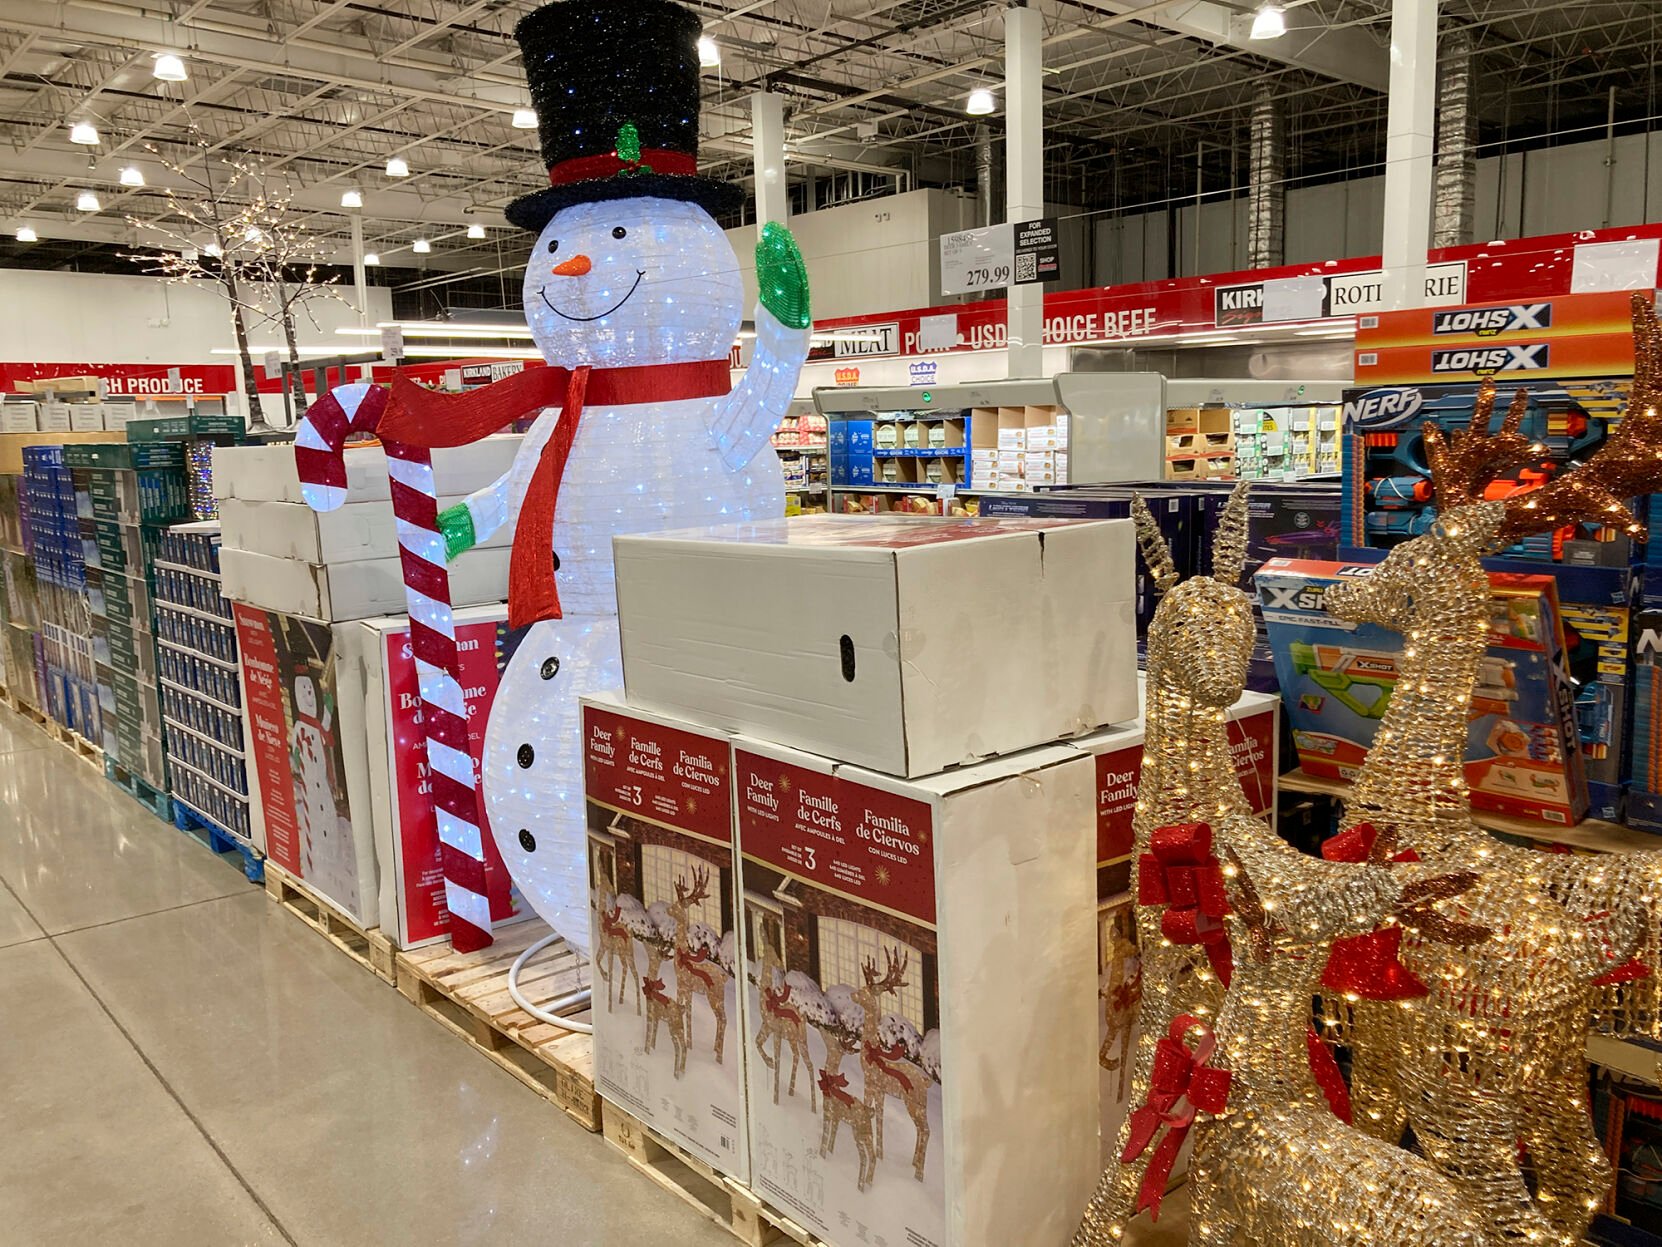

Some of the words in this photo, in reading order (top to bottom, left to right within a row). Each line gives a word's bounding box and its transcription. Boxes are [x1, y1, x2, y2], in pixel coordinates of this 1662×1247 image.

[1020, 228, 1051, 238] EXPANDED
[1020, 236, 1052, 246] SELECTION
[967, 266, 1010, 286] 279.99
[1334, 276, 1458, 305] ROTIRIE
[840, 328, 891, 354] MEAT
[971, 324, 1008, 350] USD
[1043, 314, 1096, 342] HOICE
[1104, 308, 1156, 337] BEEF
[1342, 388, 1419, 424] NERF
[1266, 588, 1327, 610] XSH
[593, 725, 611, 741] Deer
[590, 738, 614, 758] Family
[631, 736, 660, 756] Famille
[628, 750, 638, 764] de
[640, 752, 662, 771] Cerfs
[680, 749, 712, 770] Familia
[672, 761, 683, 776] de
[685, 764, 719, 786] Ciervos
[750, 772, 773, 792] Deer
[1107, 771, 1134, 786] Deer
[632, 785, 642, 806] 3
[746, 786, 778, 812] Family
[799, 788, 838, 814] Famille
[1101, 783, 1138, 804] Family
[766, 812, 778, 822] LIGHTS
[797, 804, 808, 821] de
[812, 809, 841, 832] Cerfs
[864, 808, 909, 836] Familia
[795, 822, 806, 831] AVEC
[807, 826, 830, 840] AMPOULES
[836, 835, 844, 844] DEL
[856, 823, 870, 840] de
[872, 827, 919, 856] Ciervos
[804, 846, 815, 871] 3
[868, 846, 879, 855] CON
[880, 850, 896, 861] LUCES
[897, 855, 907, 864] LED
